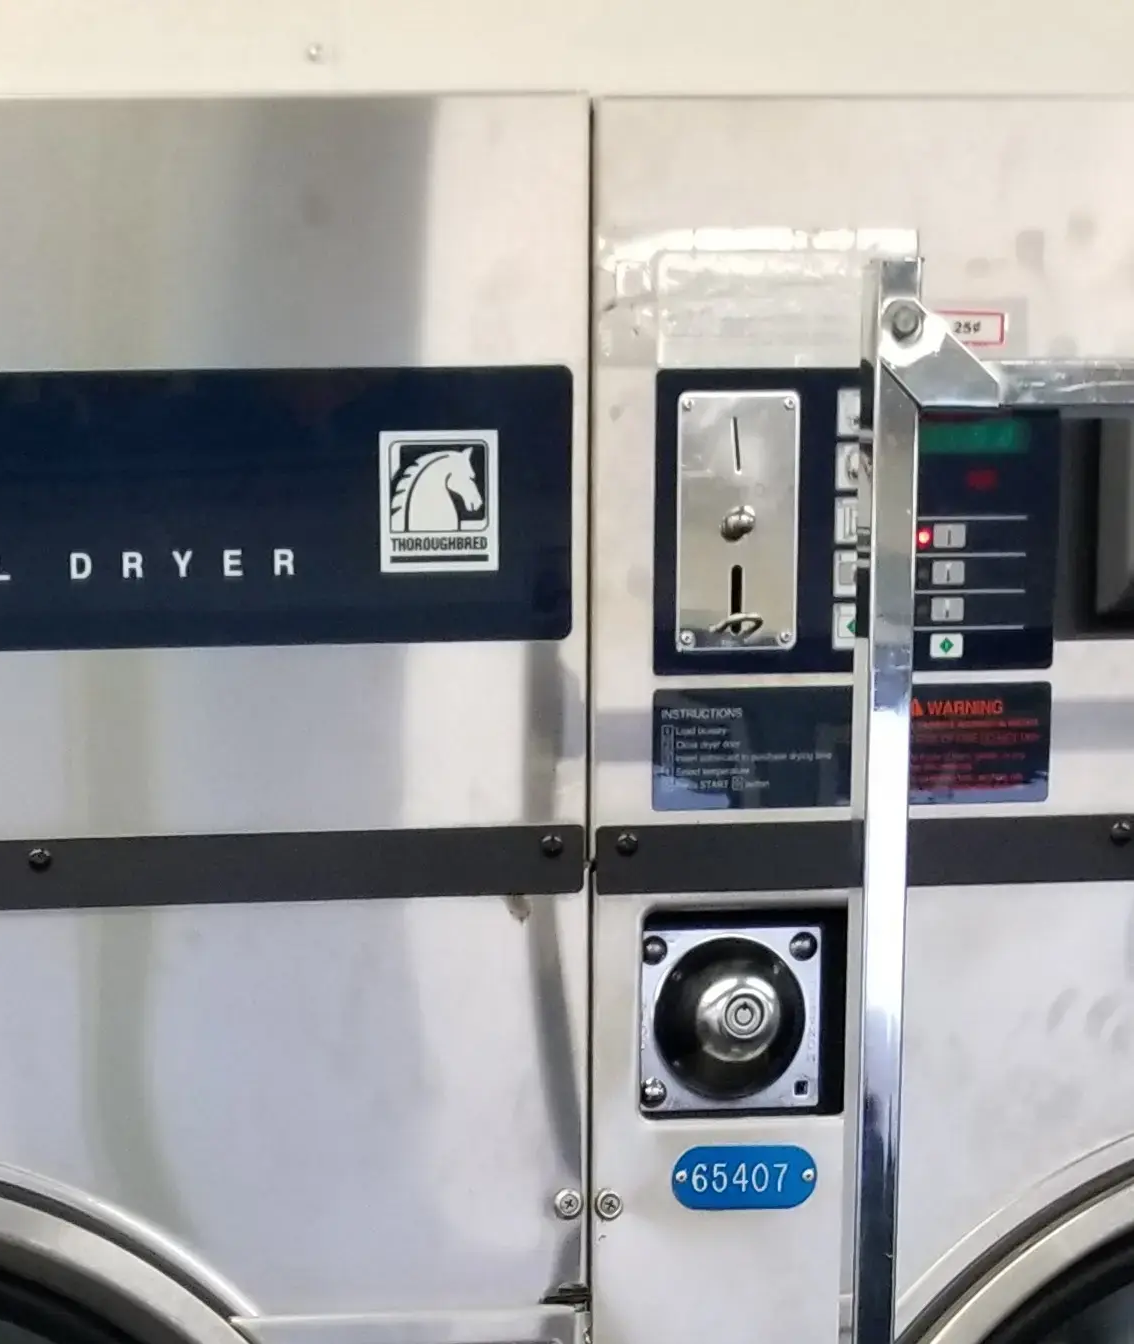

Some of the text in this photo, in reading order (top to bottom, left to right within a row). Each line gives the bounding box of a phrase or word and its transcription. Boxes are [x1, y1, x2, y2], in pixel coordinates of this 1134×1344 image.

[390, 536, 488, 552] THOROUGHBRED
[69, 548, 295, 580] DRYER
[661, 707, 743, 720] INSTRUCTIONS
[927, 699, 1003, 715] WARNING
[691, 1162, 789, 1194] 65407
